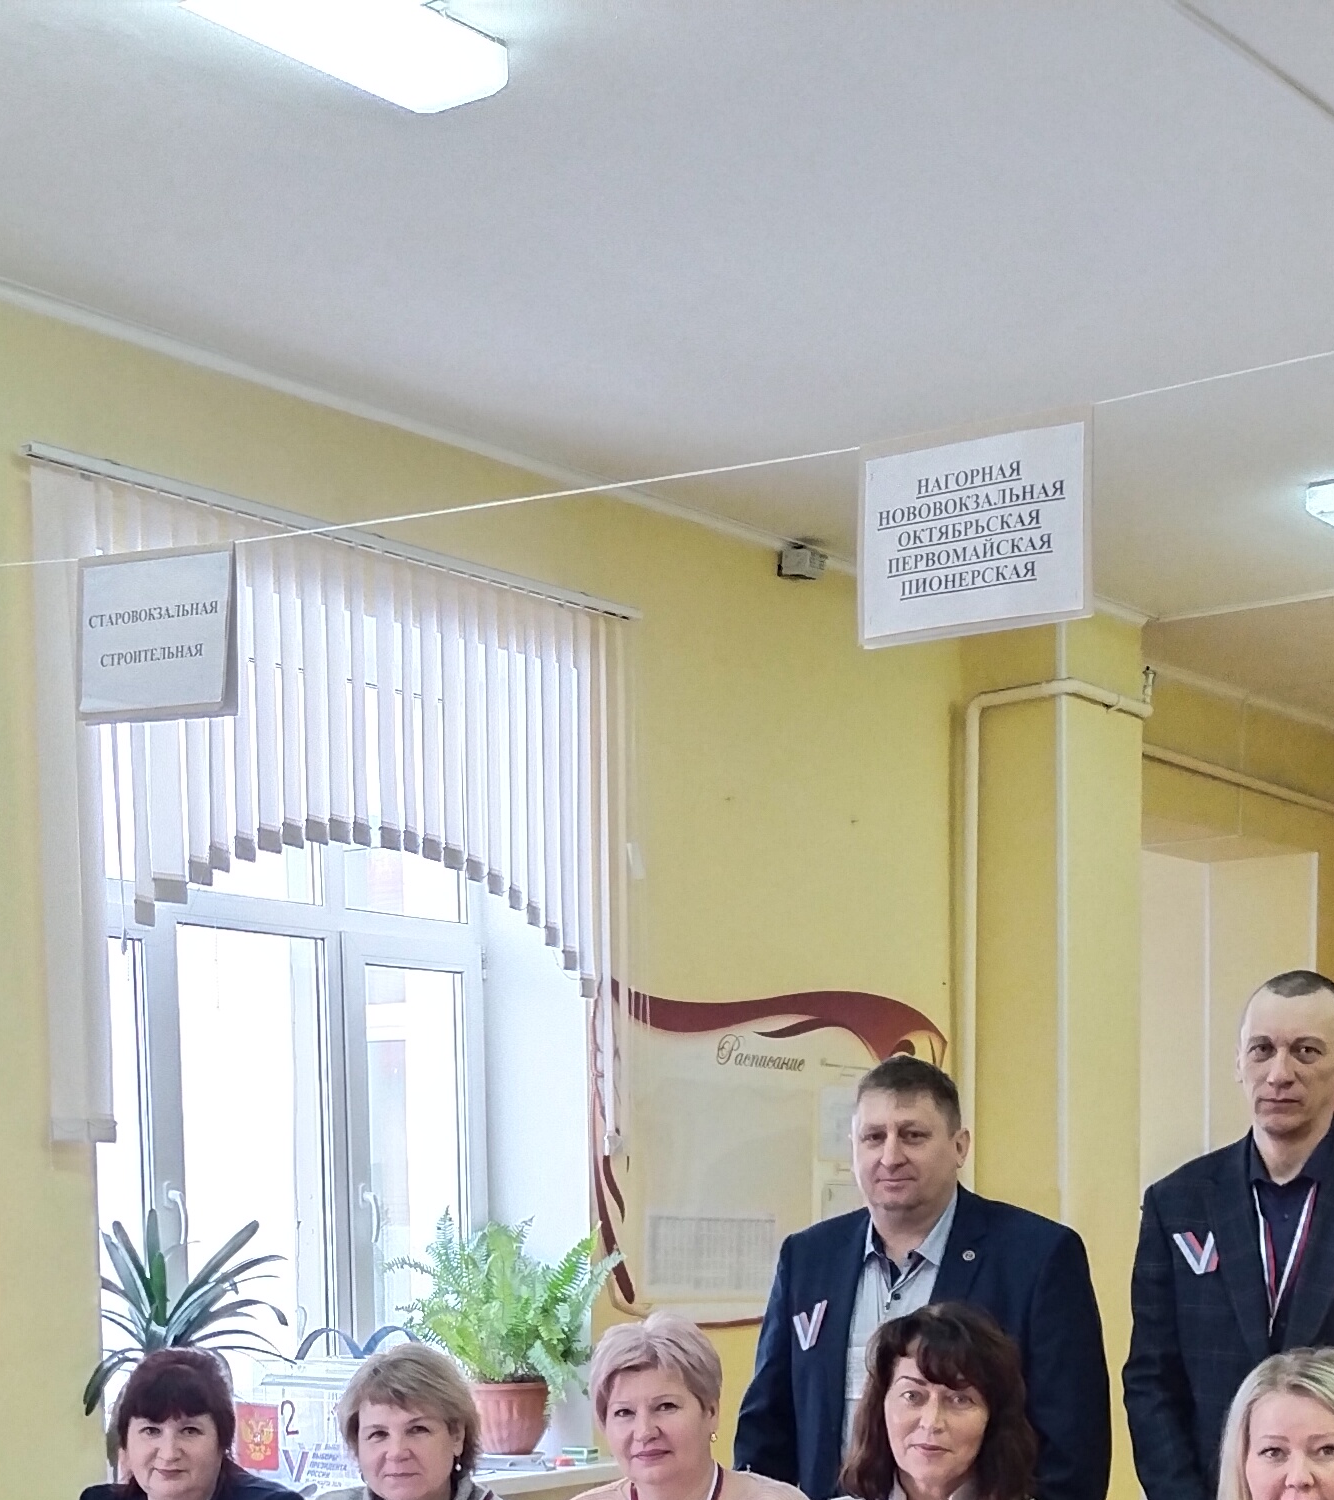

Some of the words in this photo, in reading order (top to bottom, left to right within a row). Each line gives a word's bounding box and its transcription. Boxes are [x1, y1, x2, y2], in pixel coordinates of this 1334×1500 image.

[916, 459, 1022, 498] НАГОРНАЯ
[877, 479, 1066, 530] НОВОВОКЗАЛЬНАЯ
[897, 508, 1042, 551] ОКТЯБРЬСКАЯ
[887, 532, 1053, 577] ПЕРВОМАЙСКАЯ
[900, 560, 1037, 599] ПИОНЕРСКАЯ
[88, 599, 219, 629] СТАРОВОКЗАЛЬНАЯ
[99, 642, 204, 668] СТРОИТЕЛЬНАЯ
[717, 1033, 806, 1072] Расписание
